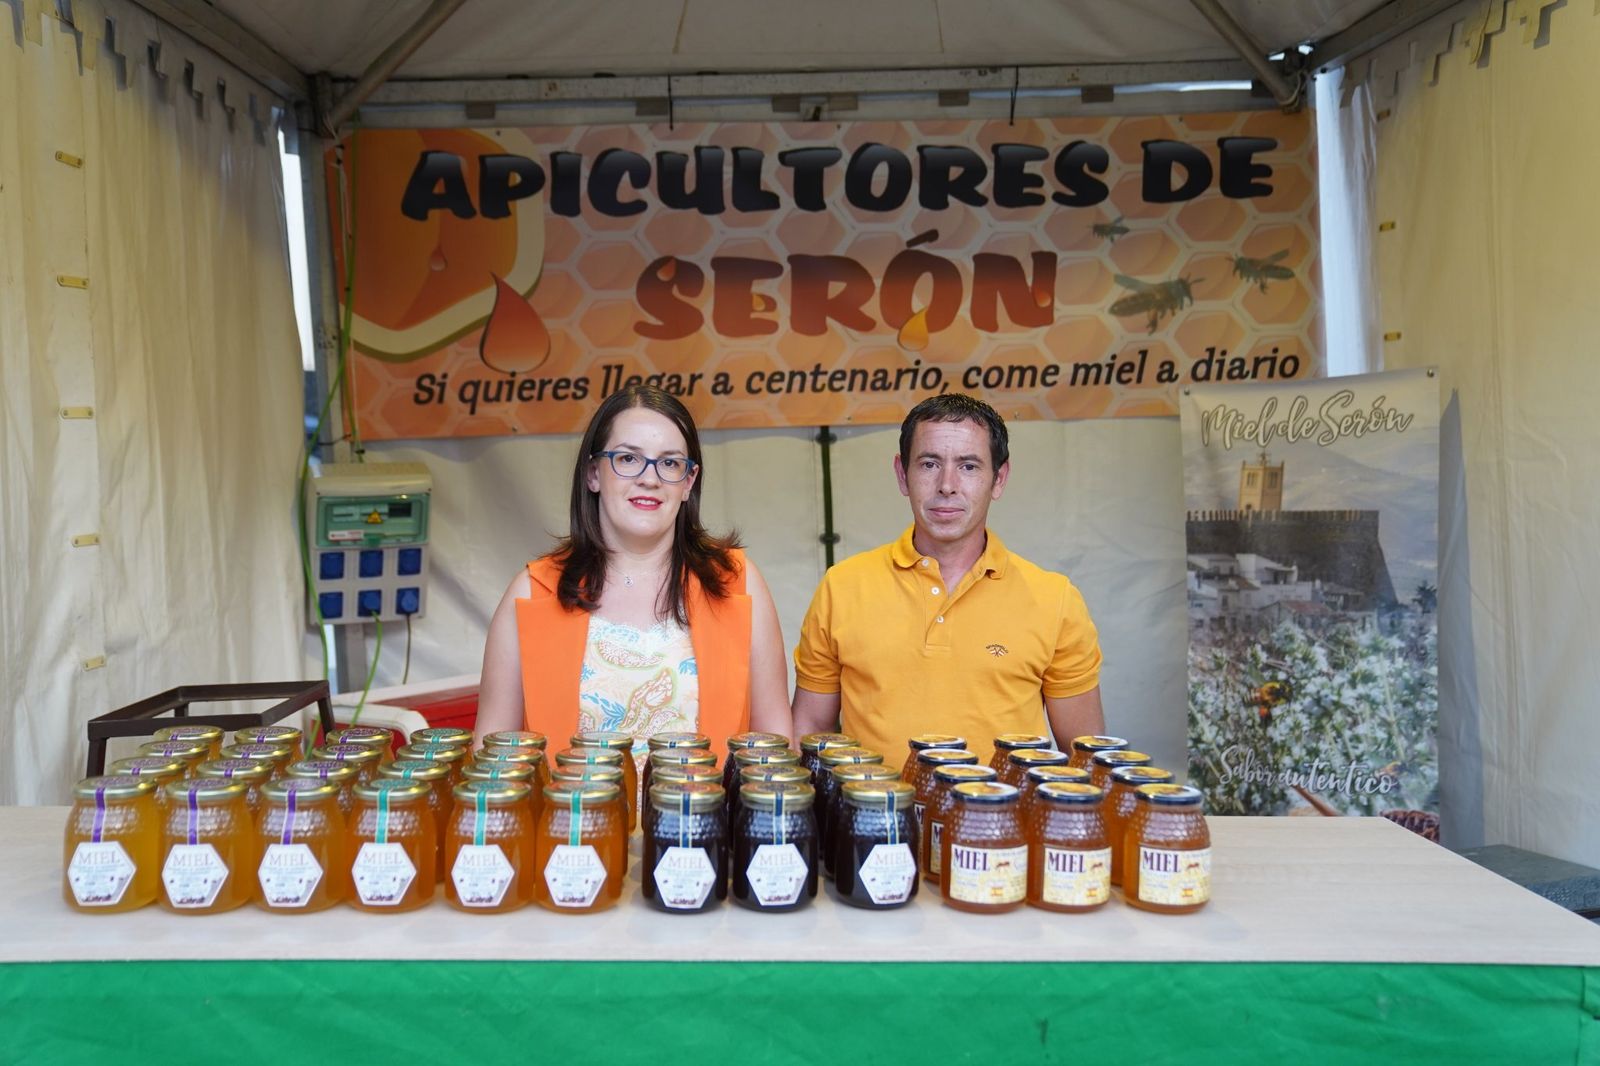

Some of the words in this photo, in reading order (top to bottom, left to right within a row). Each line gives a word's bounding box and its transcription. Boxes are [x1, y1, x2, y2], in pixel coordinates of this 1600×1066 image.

[401, 140, 1110, 221] APICULTORES
[1141, 136, 1278, 204] DE
[633, 229, 1057, 340] SERÓN
[413, 373, 449, 405] Si
[458, 370, 590, 415] quieres
[710, 370, 734, 396] a
[745, 359, 949, 395] centenario,
[962, 361, 1060, 390] come
[1069, 349, 1150, 387] miel
[1156, 358, 1180, 384] a
[1190, 347, 1301, 383] diario
[1201, 396, 1279, 450] Miel
[1276, 395, 1320, 444] de
[1316, 389, 1415, 447] Serón
[1219, 744, 1277, 787] Sabor
[78, 851, 121, 865] MIEL
[172, 853, 214, 866] MIEL
[268, 853, 309, 866] MIEL
[362, 852, 403, 865] MIEL
[462, 854, 501, 867] MIEL
[555, 853, 595, 866] MIEL
[667, 856, 706, 869] MIEL
[759, 853, 798, 866] MIEL
[874, 852, 910, 865] MIEL
[953, 848, 991, 872] MIEL
[1048, 850, 1087, 874] MIEL
[1143, 850, 1181, 873] MIEL
